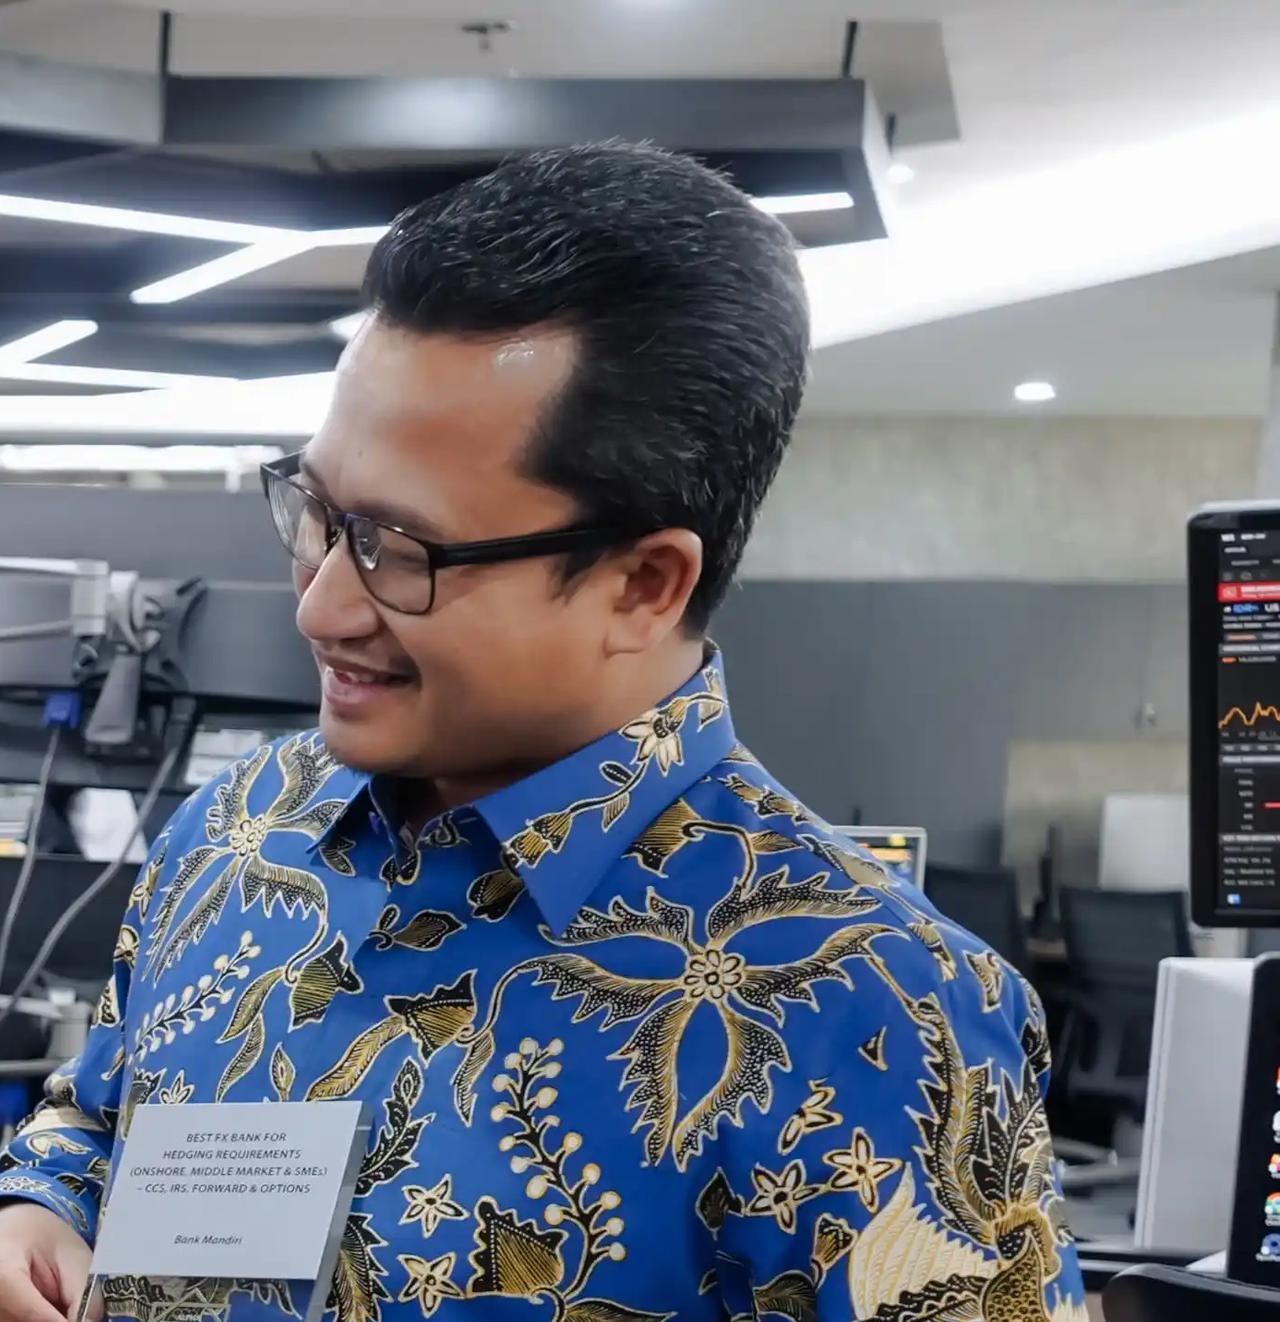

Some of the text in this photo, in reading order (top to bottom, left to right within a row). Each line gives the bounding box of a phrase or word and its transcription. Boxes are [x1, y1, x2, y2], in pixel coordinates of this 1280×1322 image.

[186, 1132, 287, 1143] BEST FX BANK FOR
[162, 1149, 302, 1160] HEDGING REQUIREMENTS
[190, 1166, 234, 1177] MIDDLE
[235, 1166, 282, 1177] MARKET
[283, 1166, 292, 1177] &
[191, 1183, 248, 1194] FORWARD
[250, 1184, 258, 1193] &
[260, 1183, 312, 1194] OPTIONS
[174, 1235, 243, 1245] Bank Mandiri
